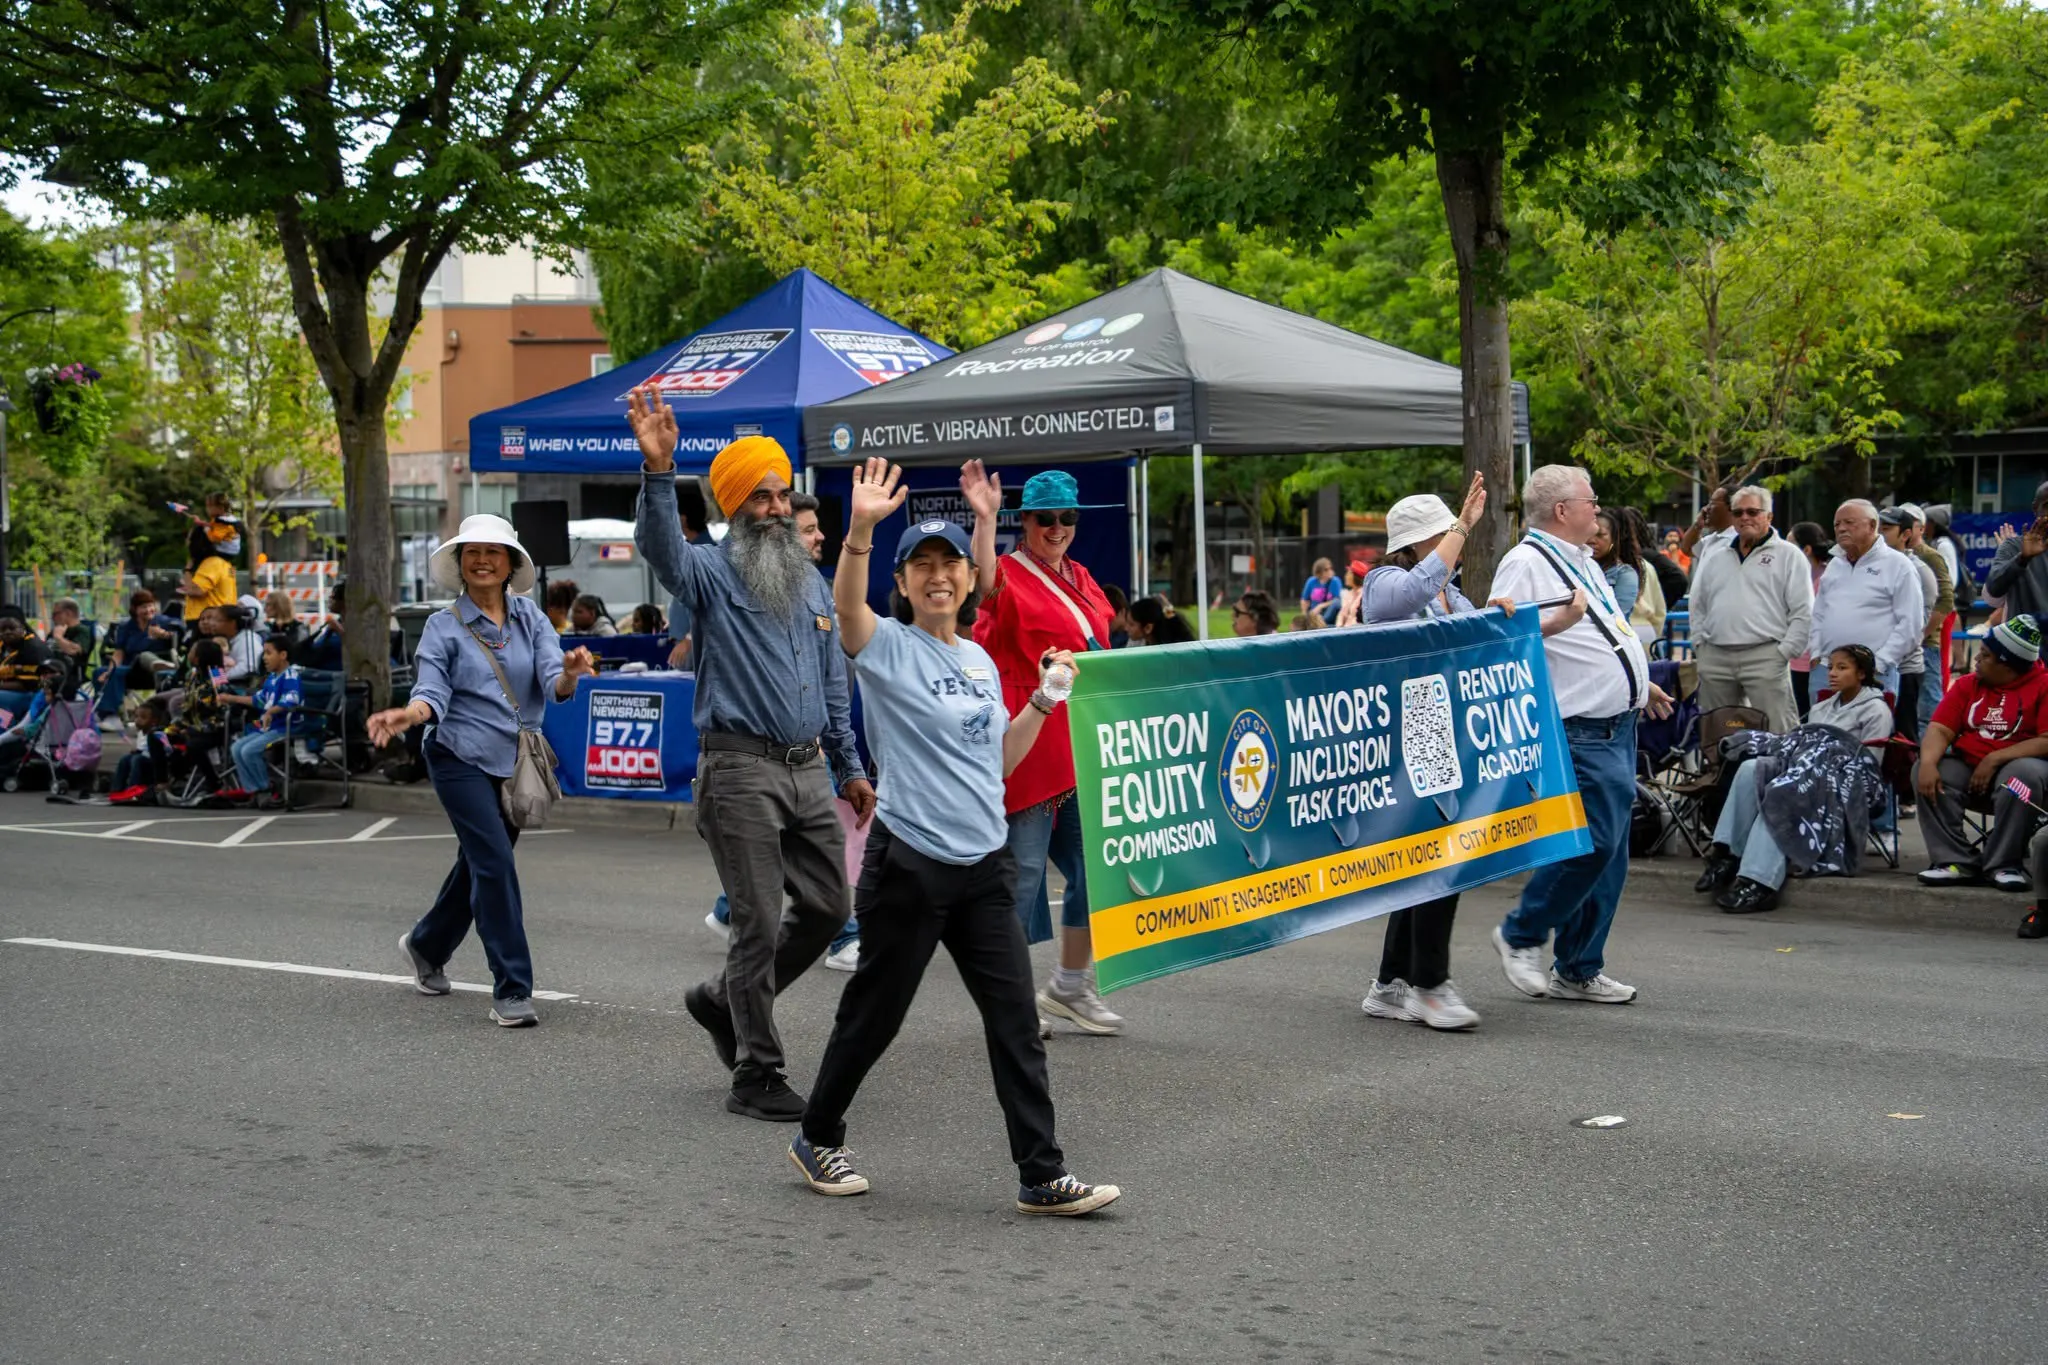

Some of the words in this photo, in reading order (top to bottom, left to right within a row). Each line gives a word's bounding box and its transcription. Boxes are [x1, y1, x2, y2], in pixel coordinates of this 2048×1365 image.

[683, 340, 777, 354] NEWSRADIO
[692, 333, 775, 346] NORTHWEST
[1011, 346, 1040, 355] CITY
[1060, 338, 1114, 350] RENTON
[666, 352, 759, 374] 97.7
[944, 348, 1135, 377] Recreation
[861, 423, 929, 447] ACTIVE.
[933, 417, 1016, 441] VIBRANT.
[1020, 407, 1149, 435] CONNECTED.
[528, 438, 575, 451] WHEN
[576, 438, 609, 450] YOU
[610, 437, 641, 451] NEE
[680, 438, 731, 451] KNOW
[1458, 659, 1535, 702] RENTON
[592, 705, 660, 720] NEWSRADIO
[593, 695, 651, 707] NORTHWEST
[1285, 684, 1391, 743] MAYOR'S
[595, 720, 653, 747] 97.7
[1233, 717, 1251, 741] CITY
[1466, 693, 1540, 751] CIVIC
[1096, 711, 1209, 768] RENTON
[599, 749, 659, 774] 1000
[1289, 734, 1391, 787] INCLUSION
[1478, 742, 1543, 783] ACADEMY
[1101, 761, 1207, 828] EQUITY
[1287, 788, 1335, 827] TASK
[1337, 775, 1398, 817] FORCE
[1231, 798, 1266, 824] RENTON
[1103, 819, 1217, 866] COMMISSION
[1136, 895, 1229, 935] COMMUNITY
[1230, 873, 1312, 913] ENGAGEMENT
[1329, 850, 1403, 886] COMMUNITY
[1406, 840, 1442, 866] VOICE
[1458, 828, 1488, 851] CITY
[1491, 824, 1503, 843] OF
[1505, 813, 1539, 839] RENTON
